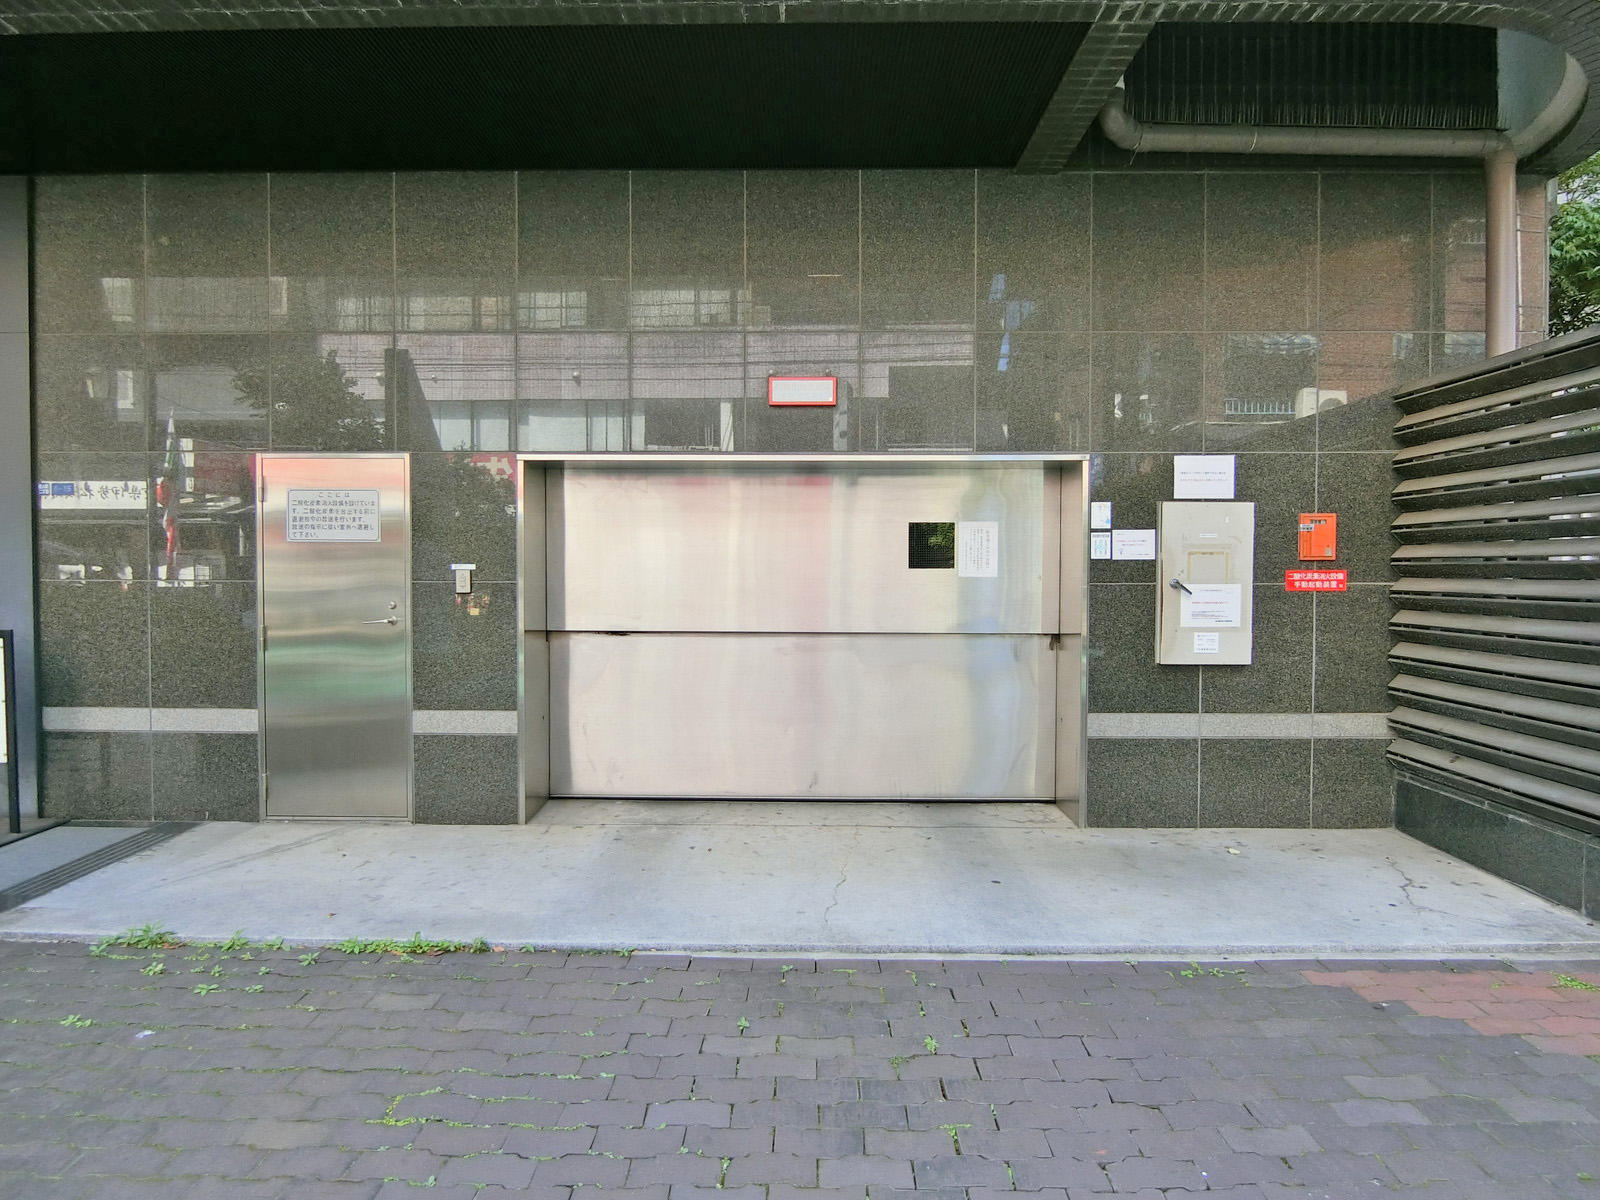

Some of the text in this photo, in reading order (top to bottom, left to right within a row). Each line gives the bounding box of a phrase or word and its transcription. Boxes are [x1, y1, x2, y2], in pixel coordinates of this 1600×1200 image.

[1287, 572, 1344, 580] 二酸化炭素消火設備
[1294, 580, 1337, 588] 手動起動装置
